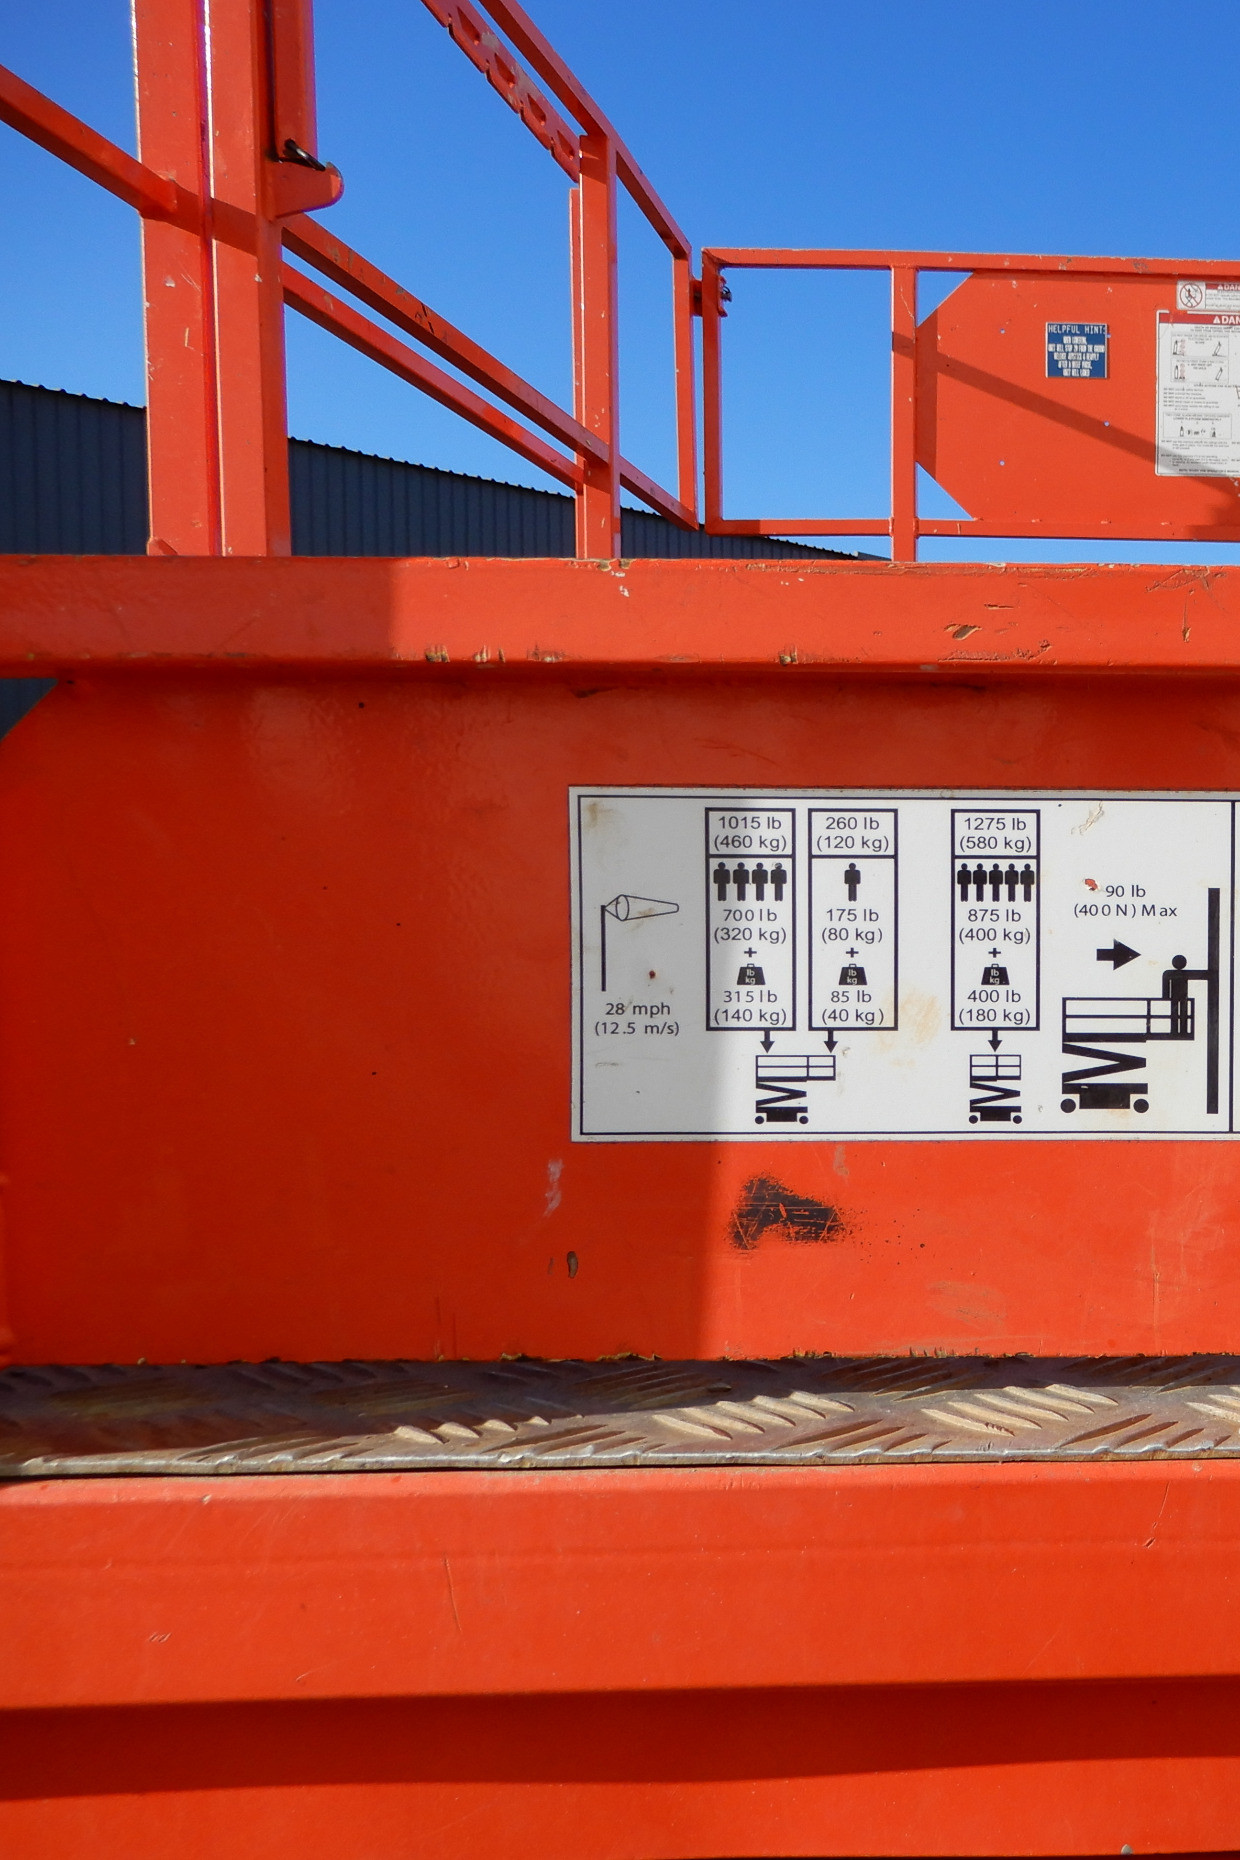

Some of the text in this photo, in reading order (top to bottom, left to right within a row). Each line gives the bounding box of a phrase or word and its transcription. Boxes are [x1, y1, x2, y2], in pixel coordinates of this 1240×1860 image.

[1048, 324, 1081, 334] HELPFUL
[718, 816, 782, 830] 1015 lb
[826, 816, 880, 830] 260 lb
[964, 817, 1027, 830] 1275 lb
[713, 834, 787, 852] (460 kg)
[816, 835, 890, 852] (120 kg)
[959, 836, 1032, 853] (580 kg)
[1105, 884, 1147, 898] 90 lb
[723, 908, 778, 922] 700 lb
[826, 908, 880, 922] 175 lb
[967, 908, 1022, 922] 875 lb
[1074, 903, 1112, 918] (400
[1141, 903, 1178, 917] Max
[713, 927, 787, 944] (320 kg)
[821, 927, 883, 944] (80 kg)
[959, 927, 1031, 945] (400 kg)
[746, 969, 756, 977] lb
[848, 969, 857, 977] lb
[990, 969, 1000, 977] lb
[745, 977, 756, 985] kg
[846, 977, 858, 985] kg
[989, 977, 1000, 985] kg
[723, 989, 778, 1003] 315 lb
[830, 989, 872, 1003] 85 lb
[967, 989, 1022, 1003] 400 lb
[605, 1001, 671, 1019] 28 mph
[713, 1008, 787, 1026] (140 kg)
[821, 1008, 885, 1026] (40 kg)
[958, 1008, 1031, 1026] (180 kg)
[594, 1021, 680, 1037] (12.5 m/s)
